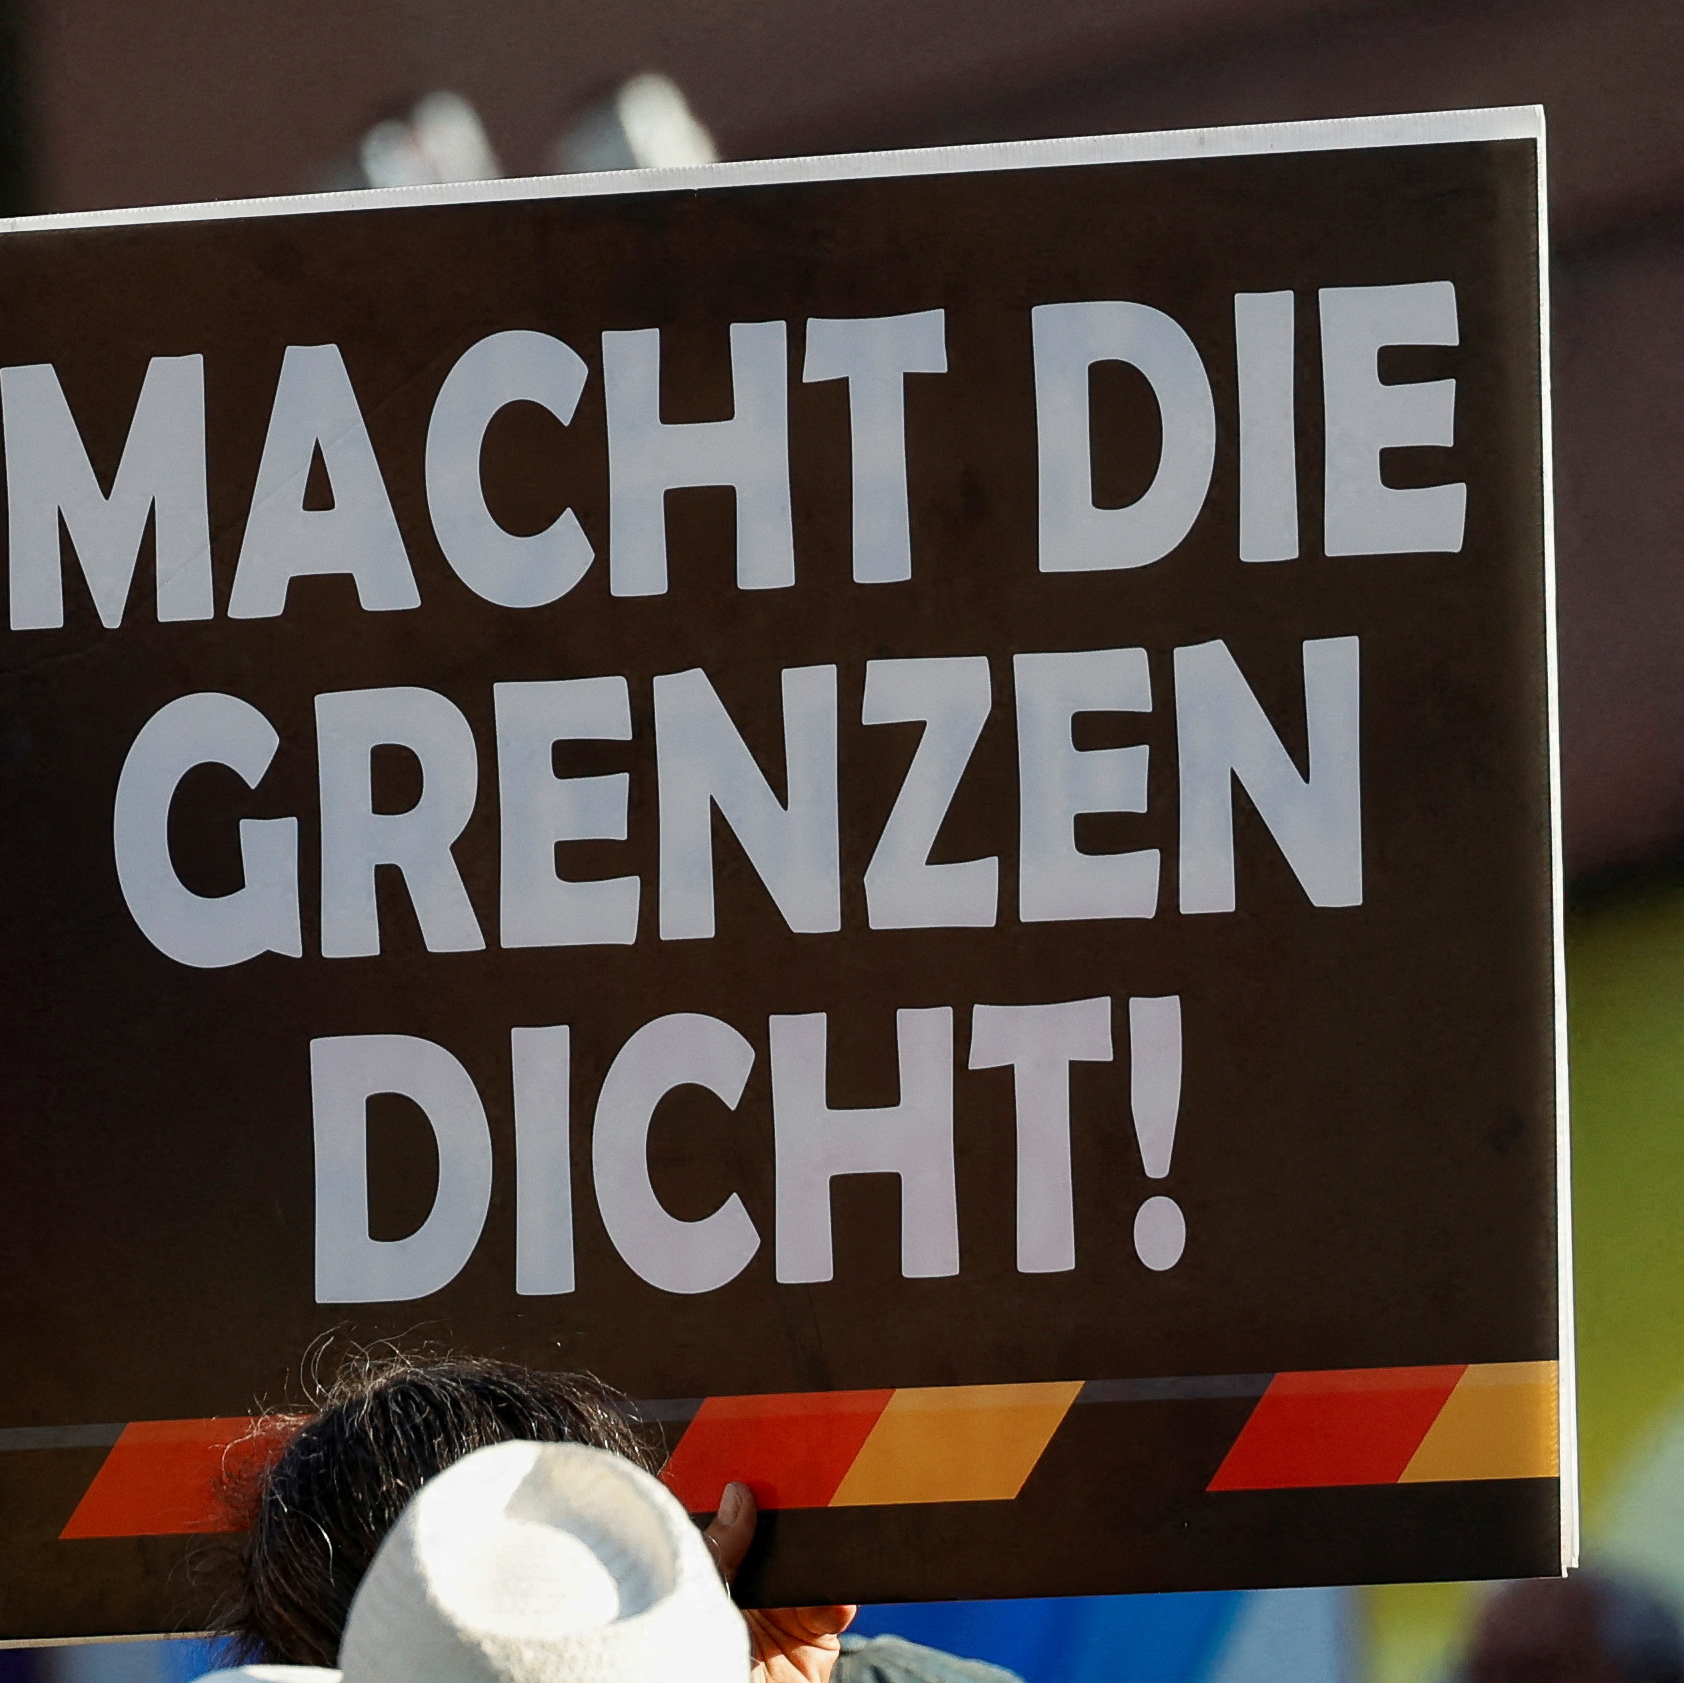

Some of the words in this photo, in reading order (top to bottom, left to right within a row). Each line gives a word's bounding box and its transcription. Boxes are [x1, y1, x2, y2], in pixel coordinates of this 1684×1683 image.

[0, 308, 948, 631] MACHT
[1031, 280, 1467, 573] DIE
[113, 635, 1363, 969] GRENZEN
[309, 994, 1186, 1304] DICHT!
